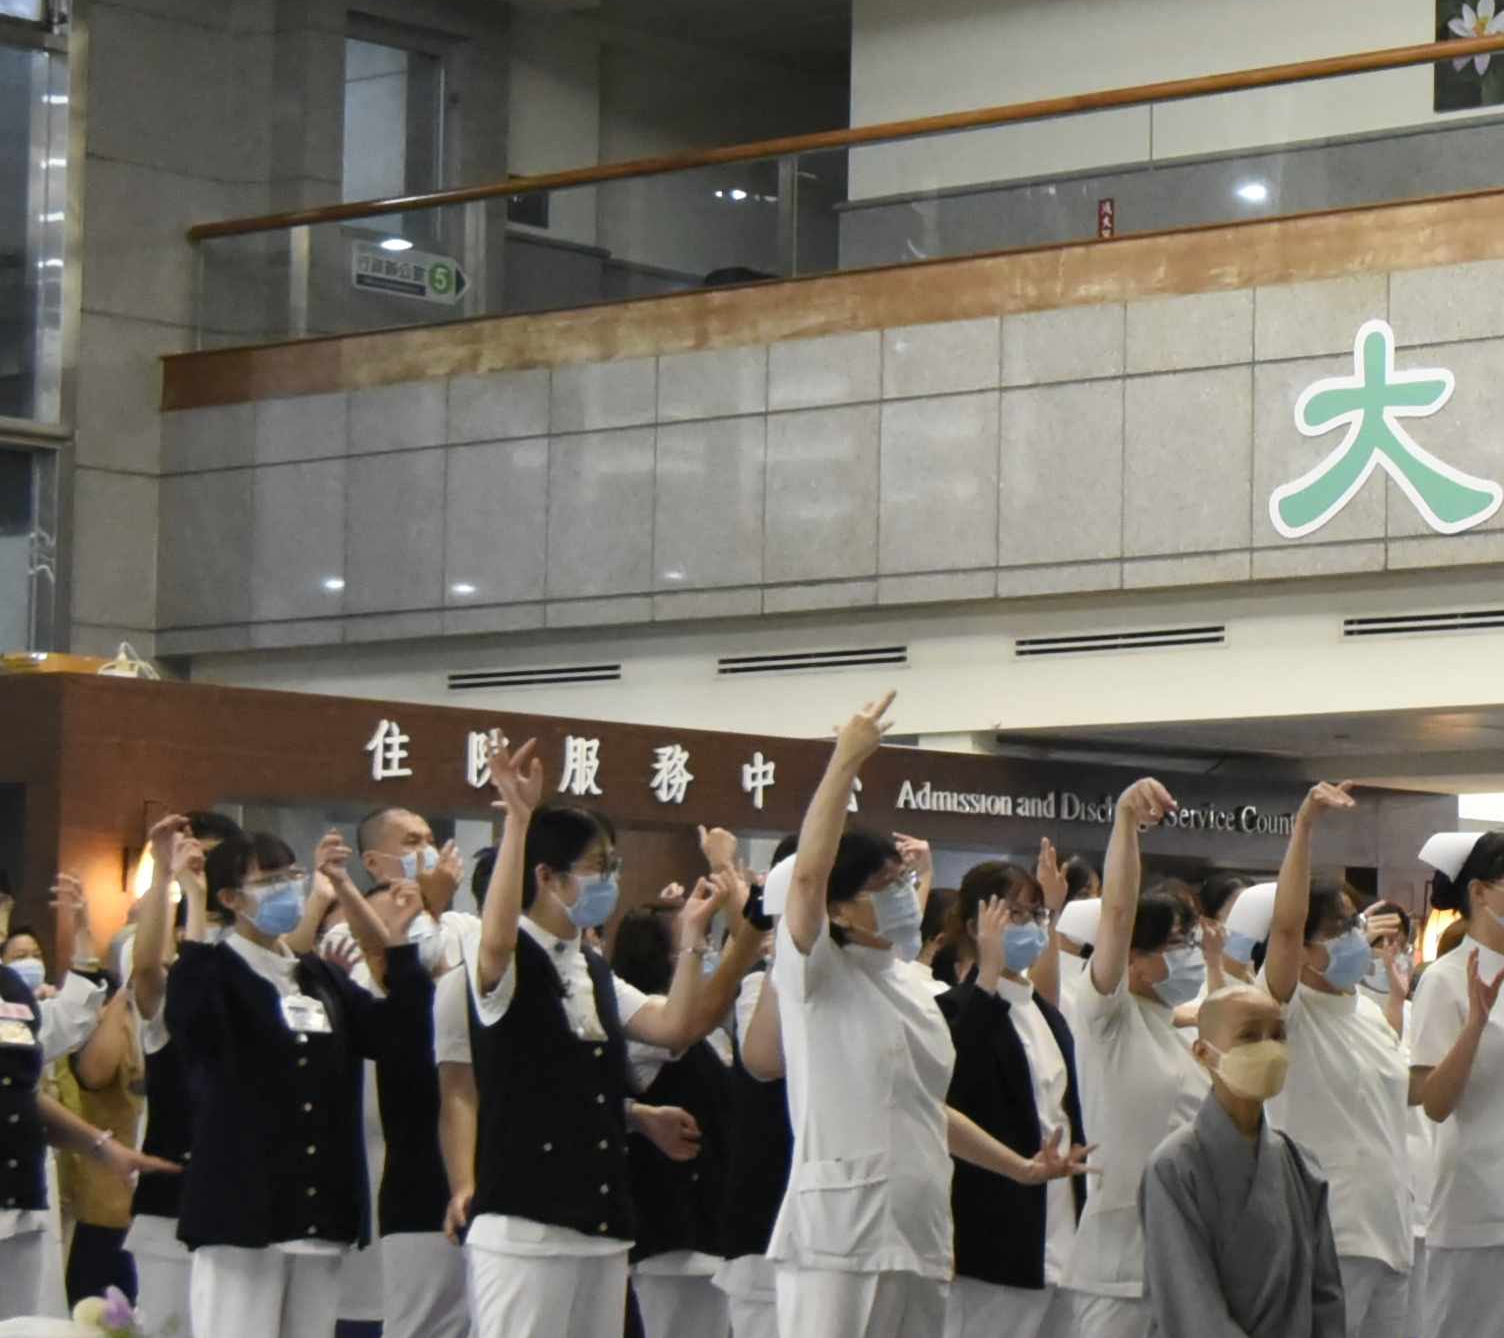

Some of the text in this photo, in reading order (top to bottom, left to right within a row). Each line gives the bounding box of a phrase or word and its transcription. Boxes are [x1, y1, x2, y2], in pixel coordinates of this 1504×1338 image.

[434, 266, 450, 291] 5
[896, 779, 1013, 818] Admission
[1015, 790, 1057, 823] and
